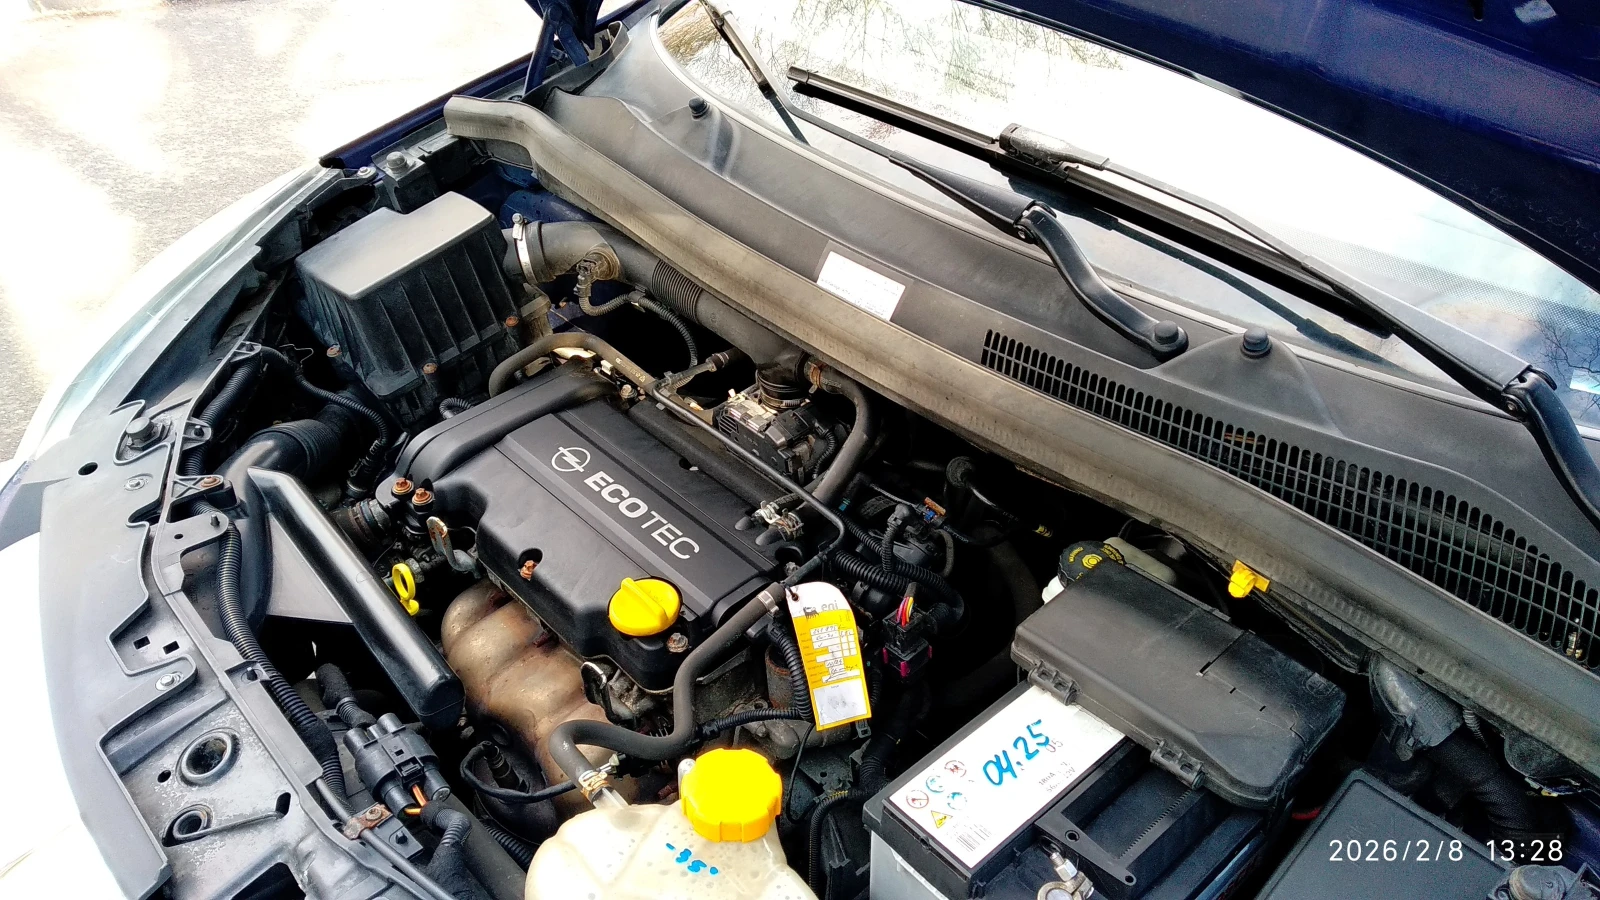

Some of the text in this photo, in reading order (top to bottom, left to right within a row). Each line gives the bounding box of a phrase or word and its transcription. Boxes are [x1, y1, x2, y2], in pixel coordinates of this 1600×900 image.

[583, 471, 700, 560] ECOTEC
[821, 600, 839, 612] eni
[983, 720, 1049, 786] 04.25
